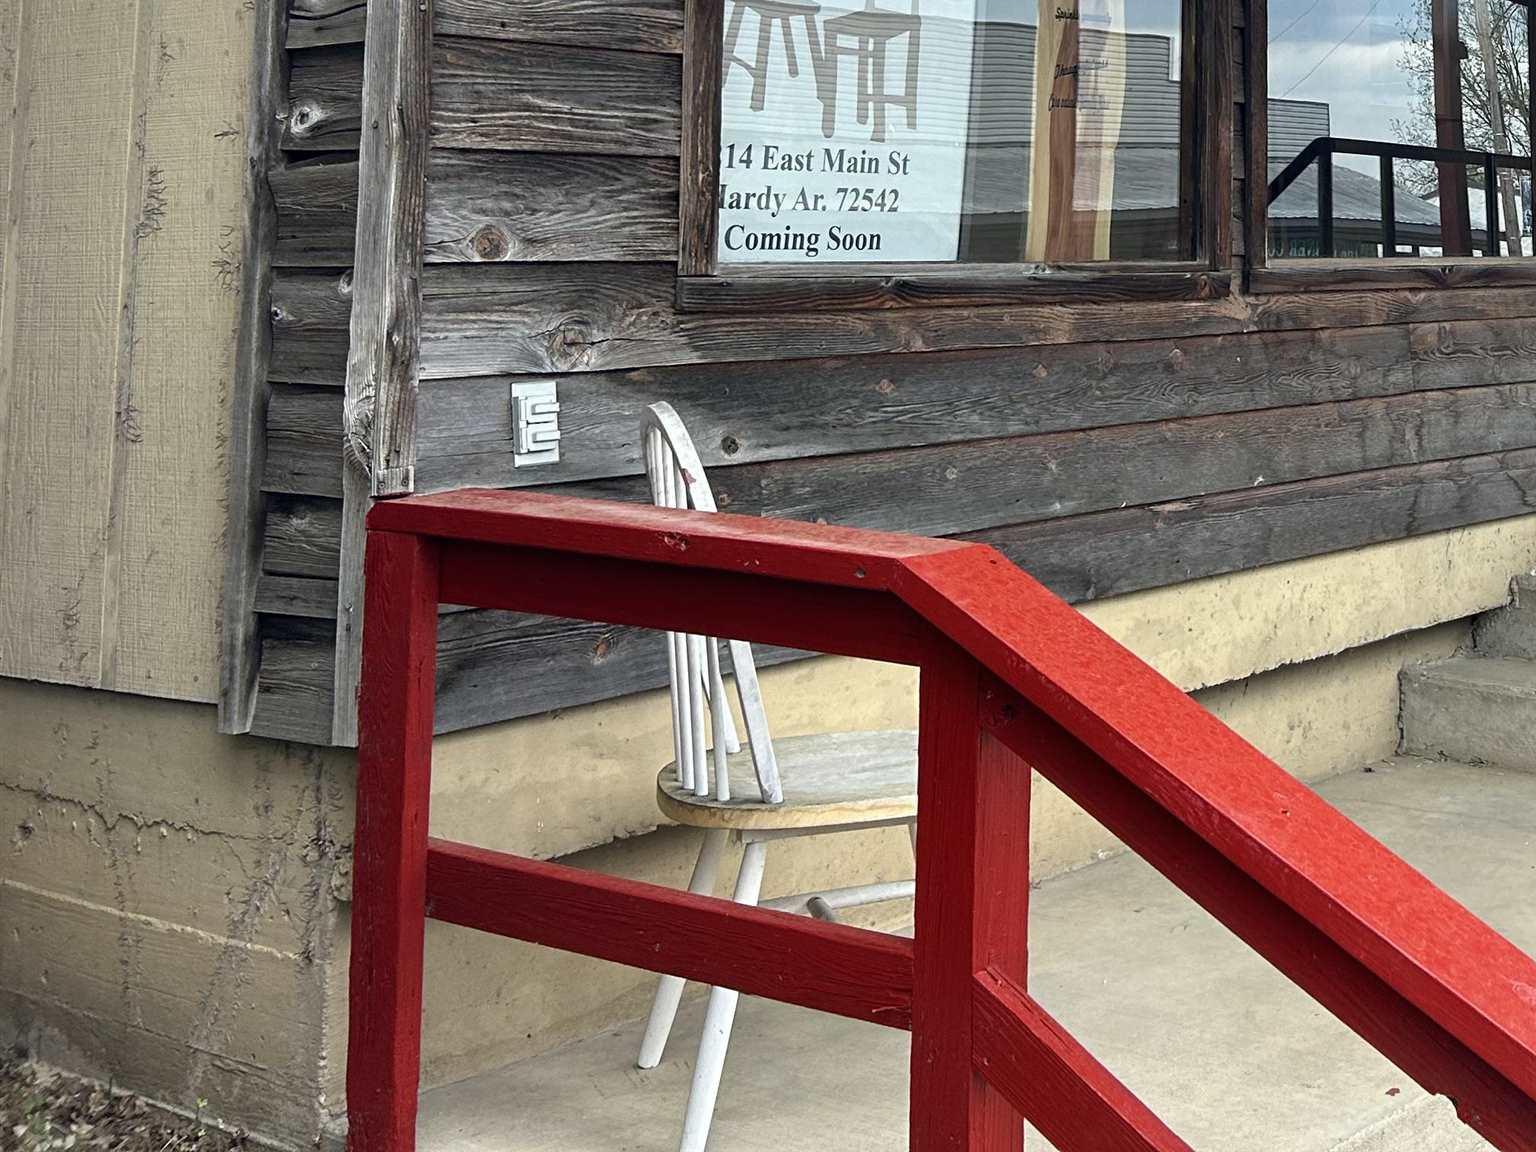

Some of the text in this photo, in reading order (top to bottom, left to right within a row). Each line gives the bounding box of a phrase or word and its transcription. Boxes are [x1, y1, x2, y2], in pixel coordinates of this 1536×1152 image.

[720, 143, 912, 176] 14 East Main St
[792, 186, 827, 211] Ar.
[836, 187, 900, 213] 72542
[724, 224, 882, 257] Coming Soon
